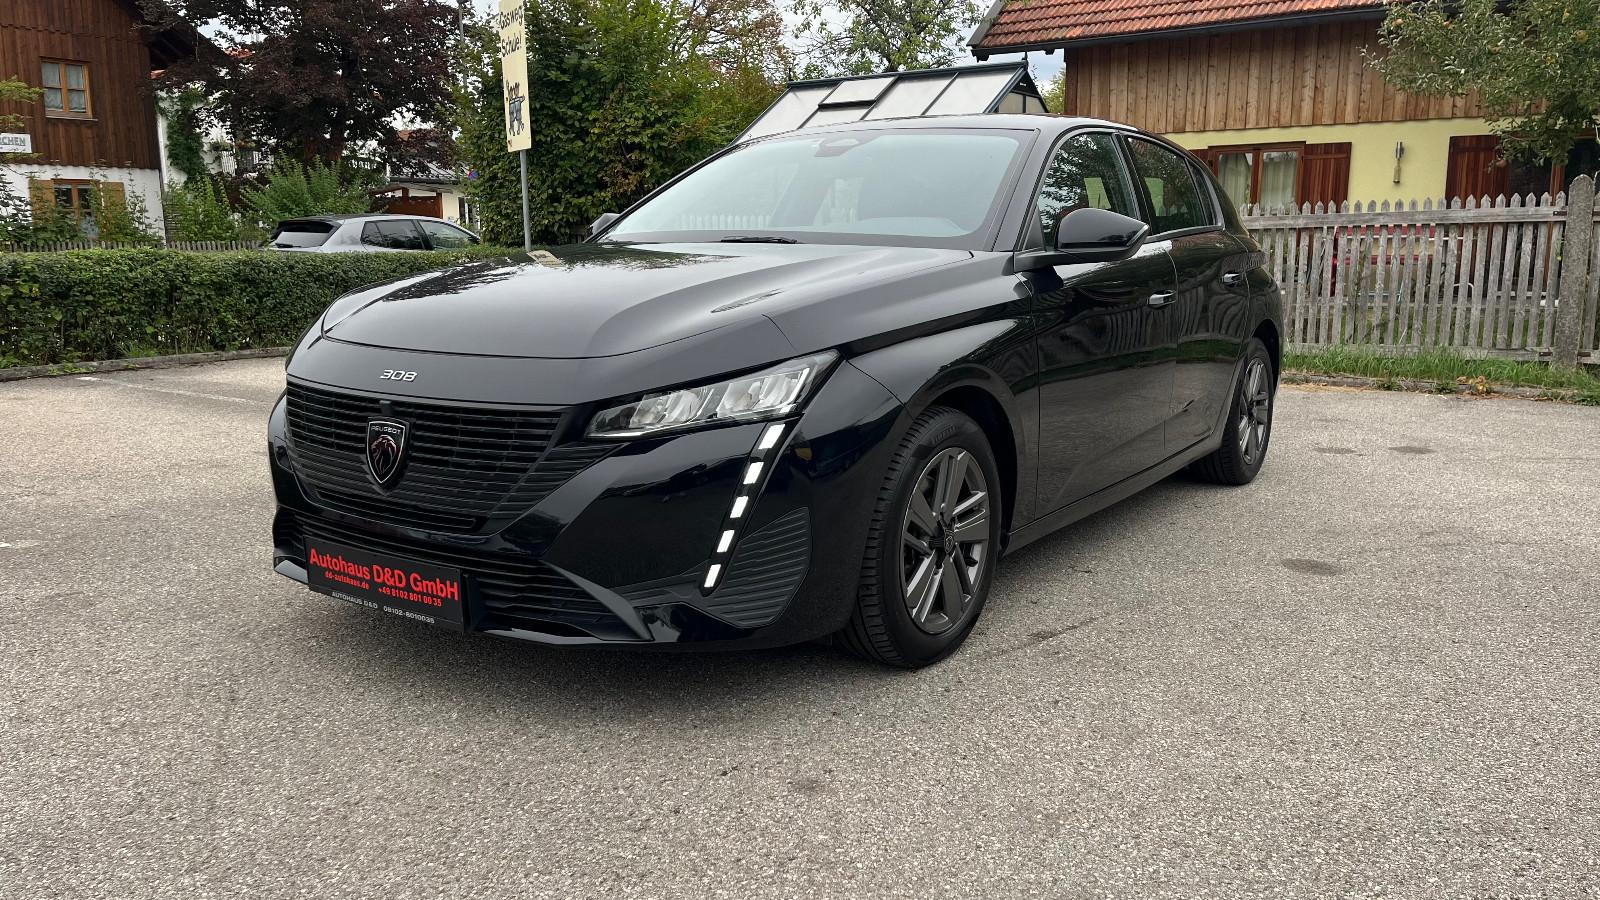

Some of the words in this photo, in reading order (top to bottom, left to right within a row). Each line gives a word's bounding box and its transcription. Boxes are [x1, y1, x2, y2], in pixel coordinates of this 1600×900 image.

[380, 369, 417, 382] 308
[371, 425, 401, 434] PEUGEOT
[310, 548, 370, 580] Autohaus
[372, 564, 407, 588] D&D
[409, 573, 458, 601] GmbH
[378, 586, 391, 596] +49
[391, 588, 408, 599] 8102
[409, 592, 422, 602] 801
[423, 595, 432, 605] 00
[433, 598, 442, 607] 35
[332, 591, 362, 605] AUTOHAUS
[363, 600, 378, 609] D&D
[383, 605, 435, 624] 08102-8010035
